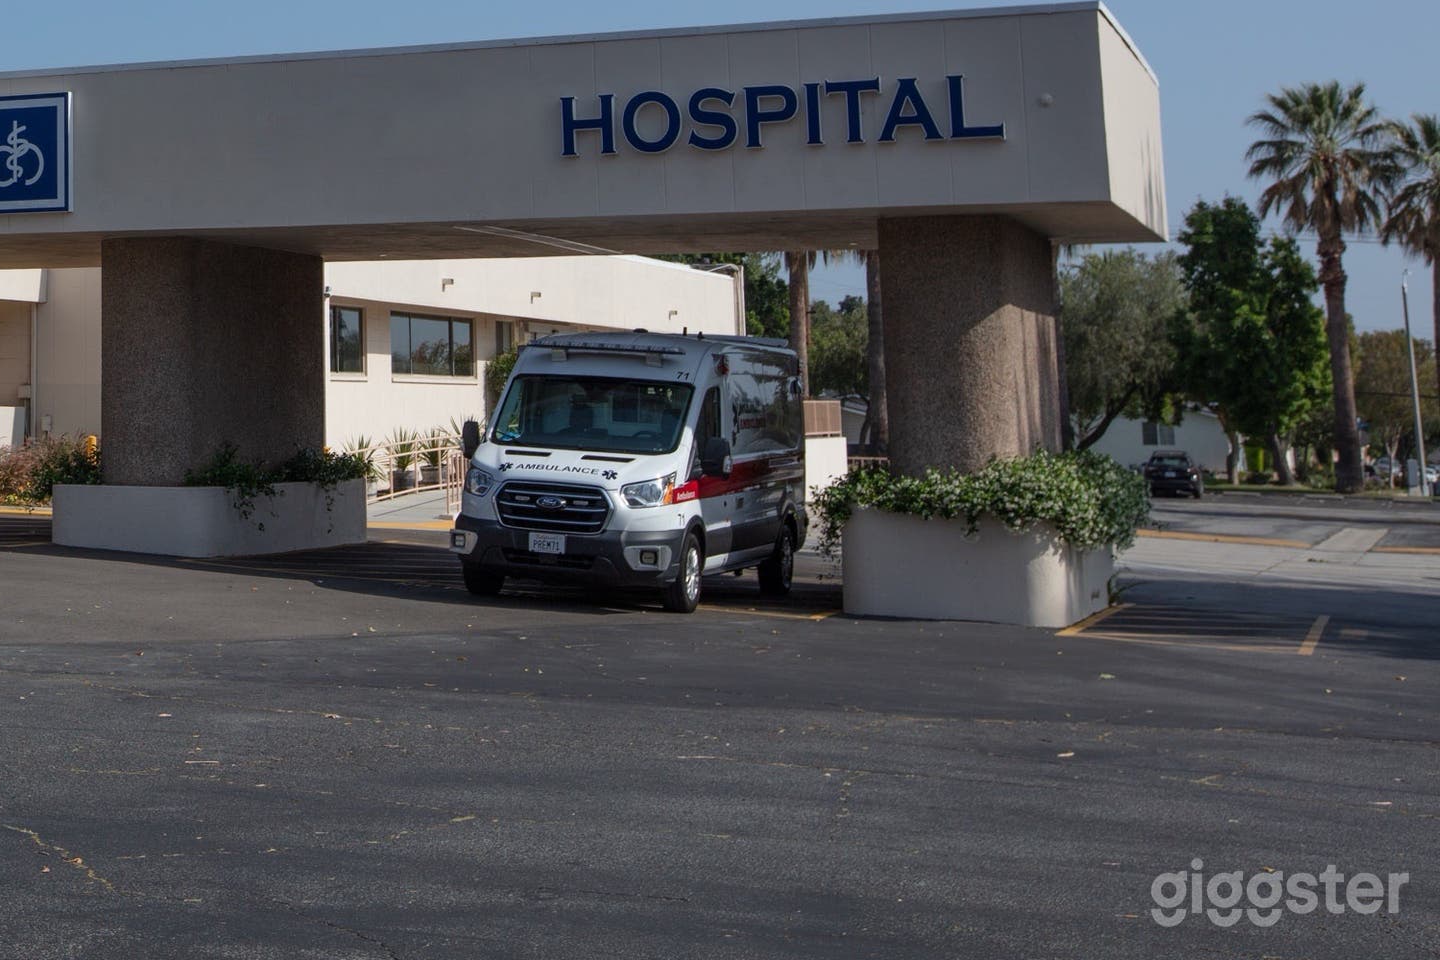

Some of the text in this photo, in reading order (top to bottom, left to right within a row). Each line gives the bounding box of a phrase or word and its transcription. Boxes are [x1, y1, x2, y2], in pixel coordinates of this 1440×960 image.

[560, 74, 1007, 157] HOSPITAL
[676, 371, 690, 381] 71
[515, 463, 600, 475] AMBULANCE
